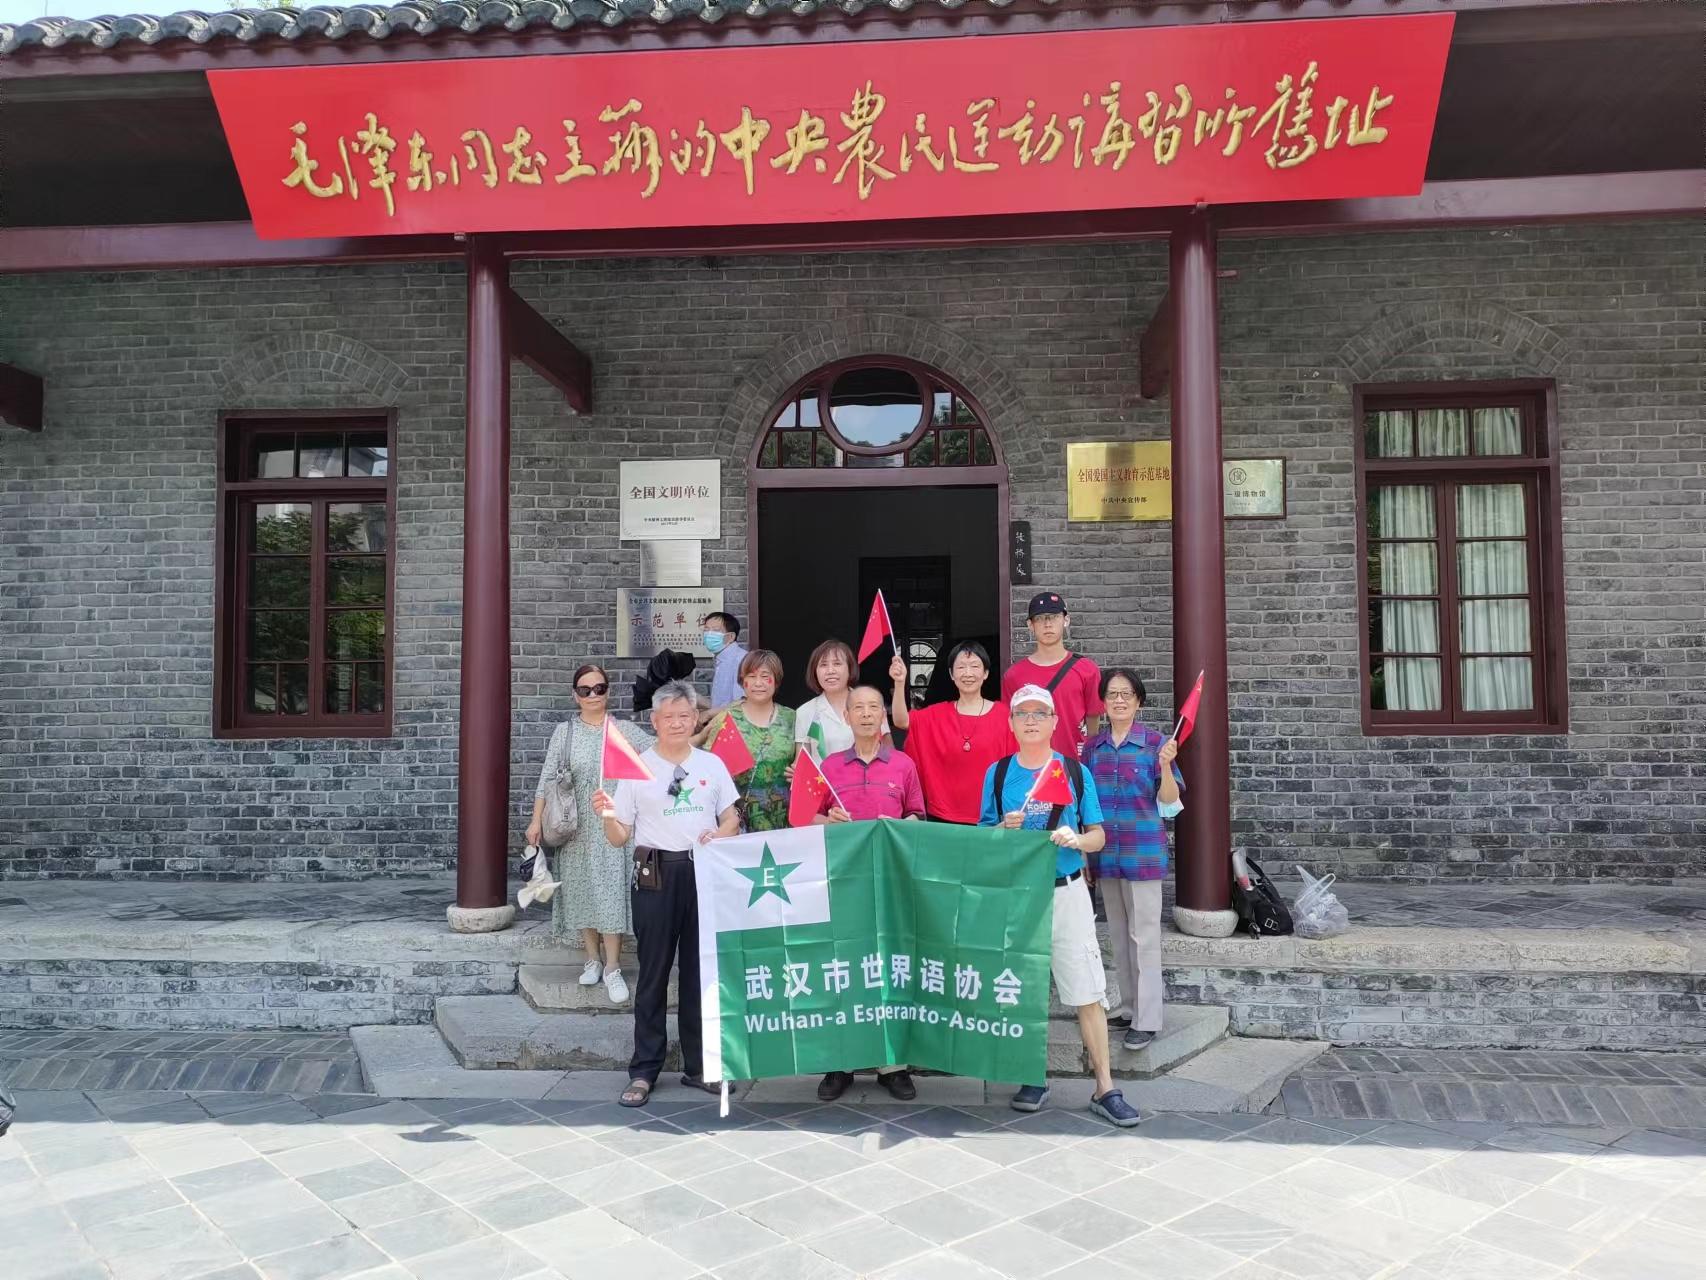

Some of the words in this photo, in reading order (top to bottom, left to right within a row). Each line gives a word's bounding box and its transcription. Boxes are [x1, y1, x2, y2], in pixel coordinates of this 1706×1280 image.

[1077, 467, 1170, 483] 全国爱国主义教育示范基地
[630, 485, 710, 499] 全国文明单位
[663, 806, 704, 816] Esperanto
[763, 867, 775, 887] E
[744, 952, 1023, 1006] 武汉市世界语协会
[744, 1008, 847, 1034] Wuhan-a
[852, 1003, 1025, 1039] Esperanto-Asocio
